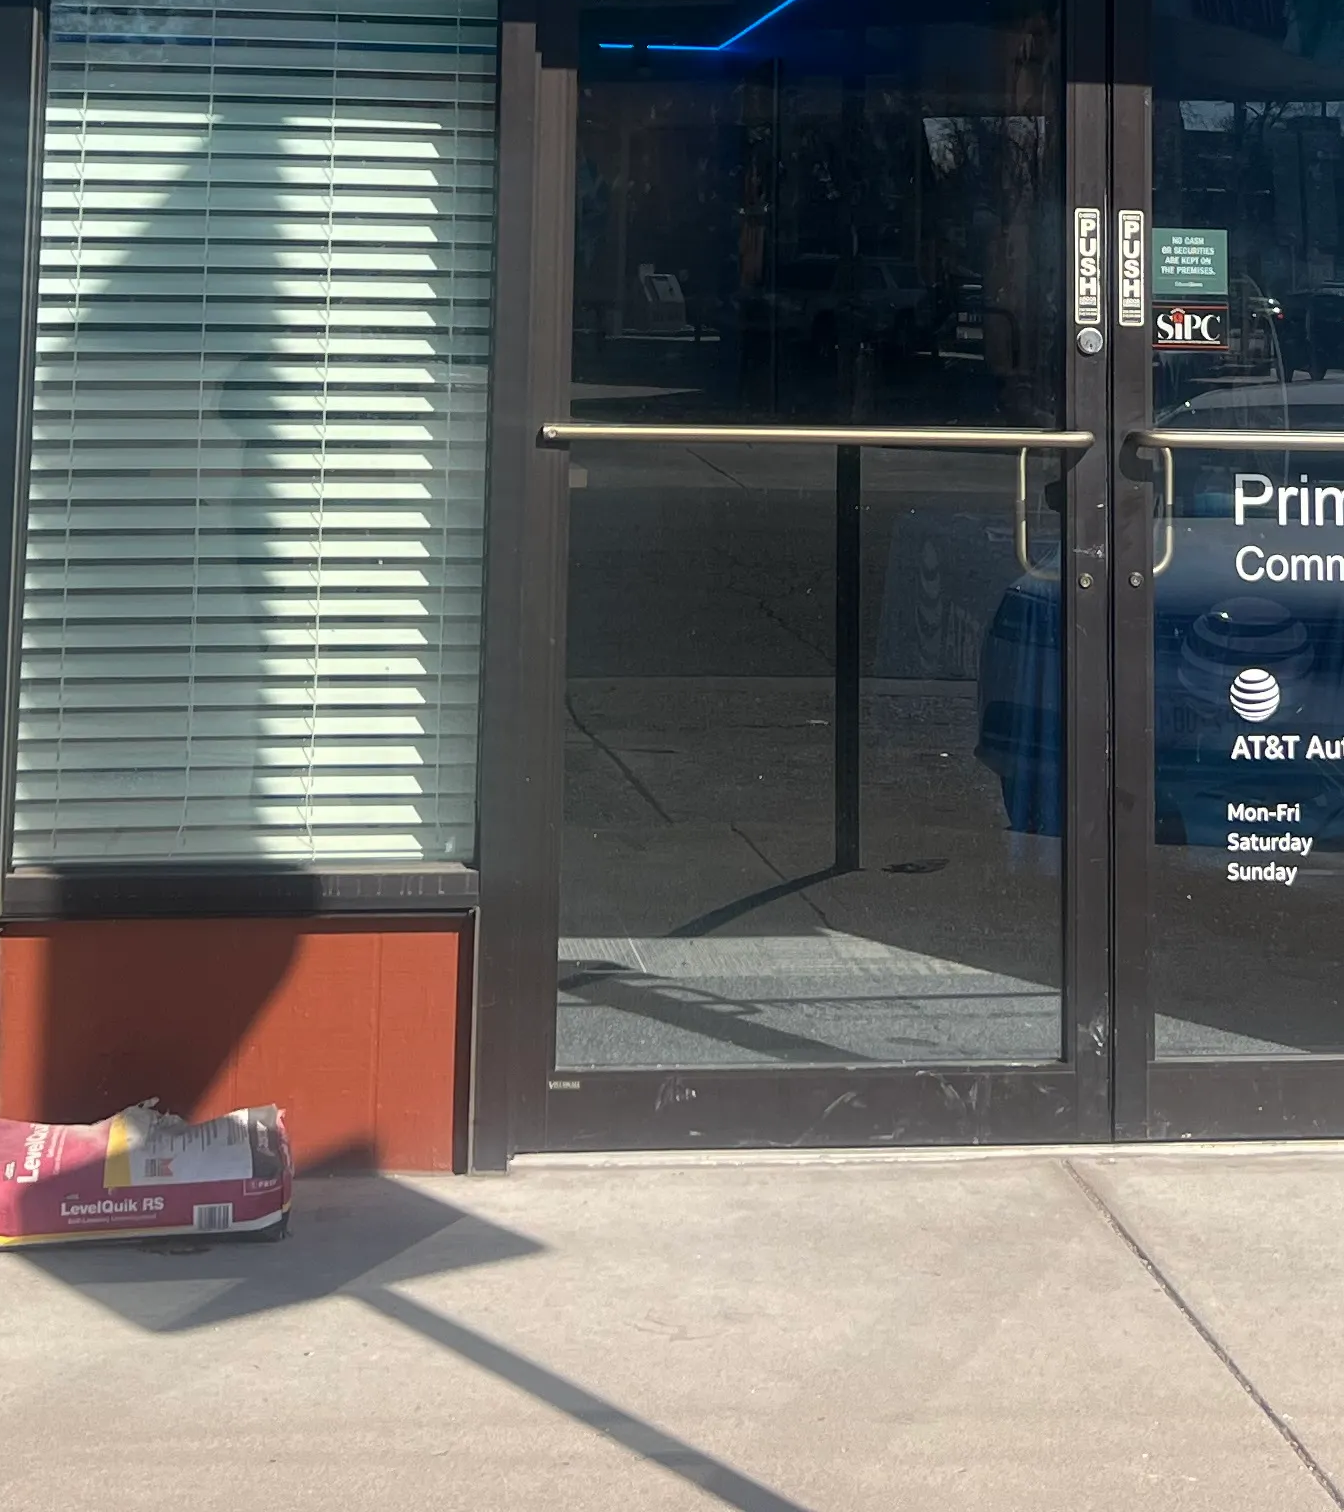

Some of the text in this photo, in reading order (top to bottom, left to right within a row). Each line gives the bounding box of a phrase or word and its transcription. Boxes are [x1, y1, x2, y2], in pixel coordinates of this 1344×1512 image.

[1161, 246, 1215, 255] OR SECURITIES
[1172, 236, 1204, 245] NO CASH
[1079, 219, 1097, 295] PUSH
[1123, 221, 1141, 297] PUSH
[1165, 256, 1212, 265] ARE KEPT ON
[1161, 265, 1175, 274] THE
[1231, 735, 1300, 759] AT&T
[1227, 803, 1301, 823] Mon-Fri
[1227, 832, 1313, 856] Saturday
[1227, 861, 1298, 886] Sunday
[60, 1196, 165, 1216] LevelQuik RS
